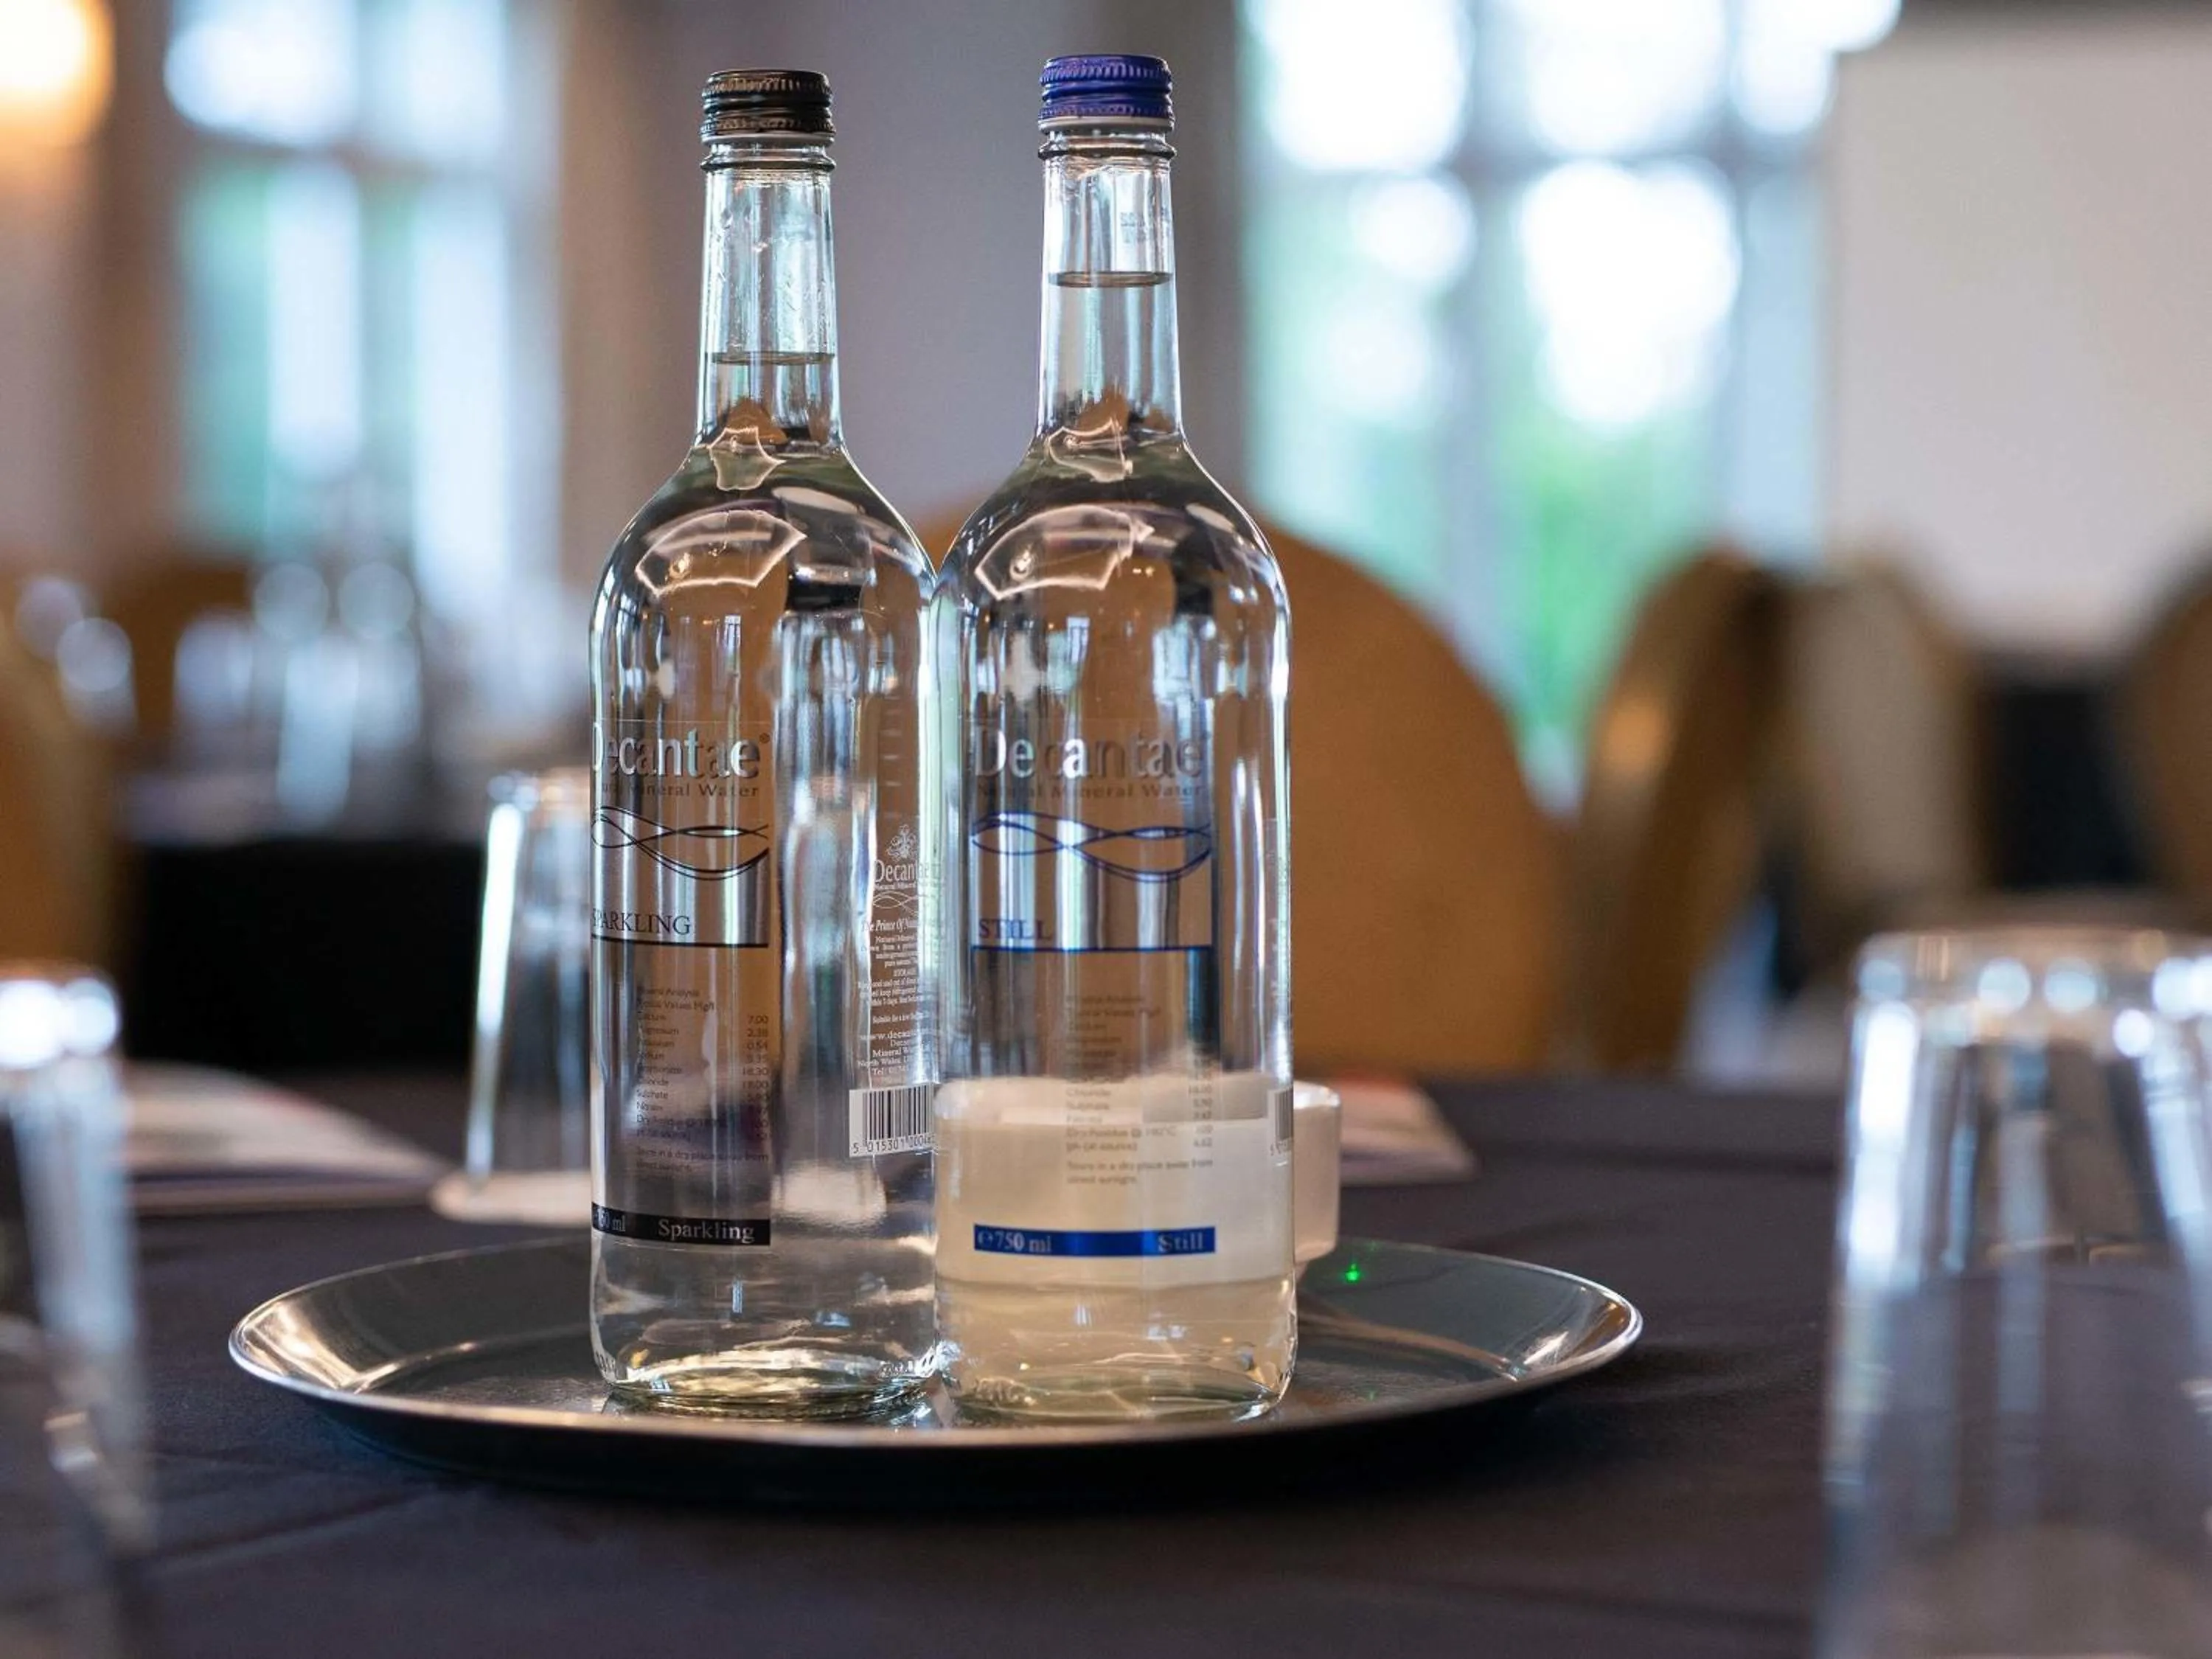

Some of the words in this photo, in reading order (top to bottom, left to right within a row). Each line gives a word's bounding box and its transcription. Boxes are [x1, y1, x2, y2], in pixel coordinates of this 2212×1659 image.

[974, 726, 1203, 779] Decantae
[979, 918, 1052, 939] STILL
[658, 1217, 755, 1244] Sparkling
[1158, 1231, 1204, 1253] Still
